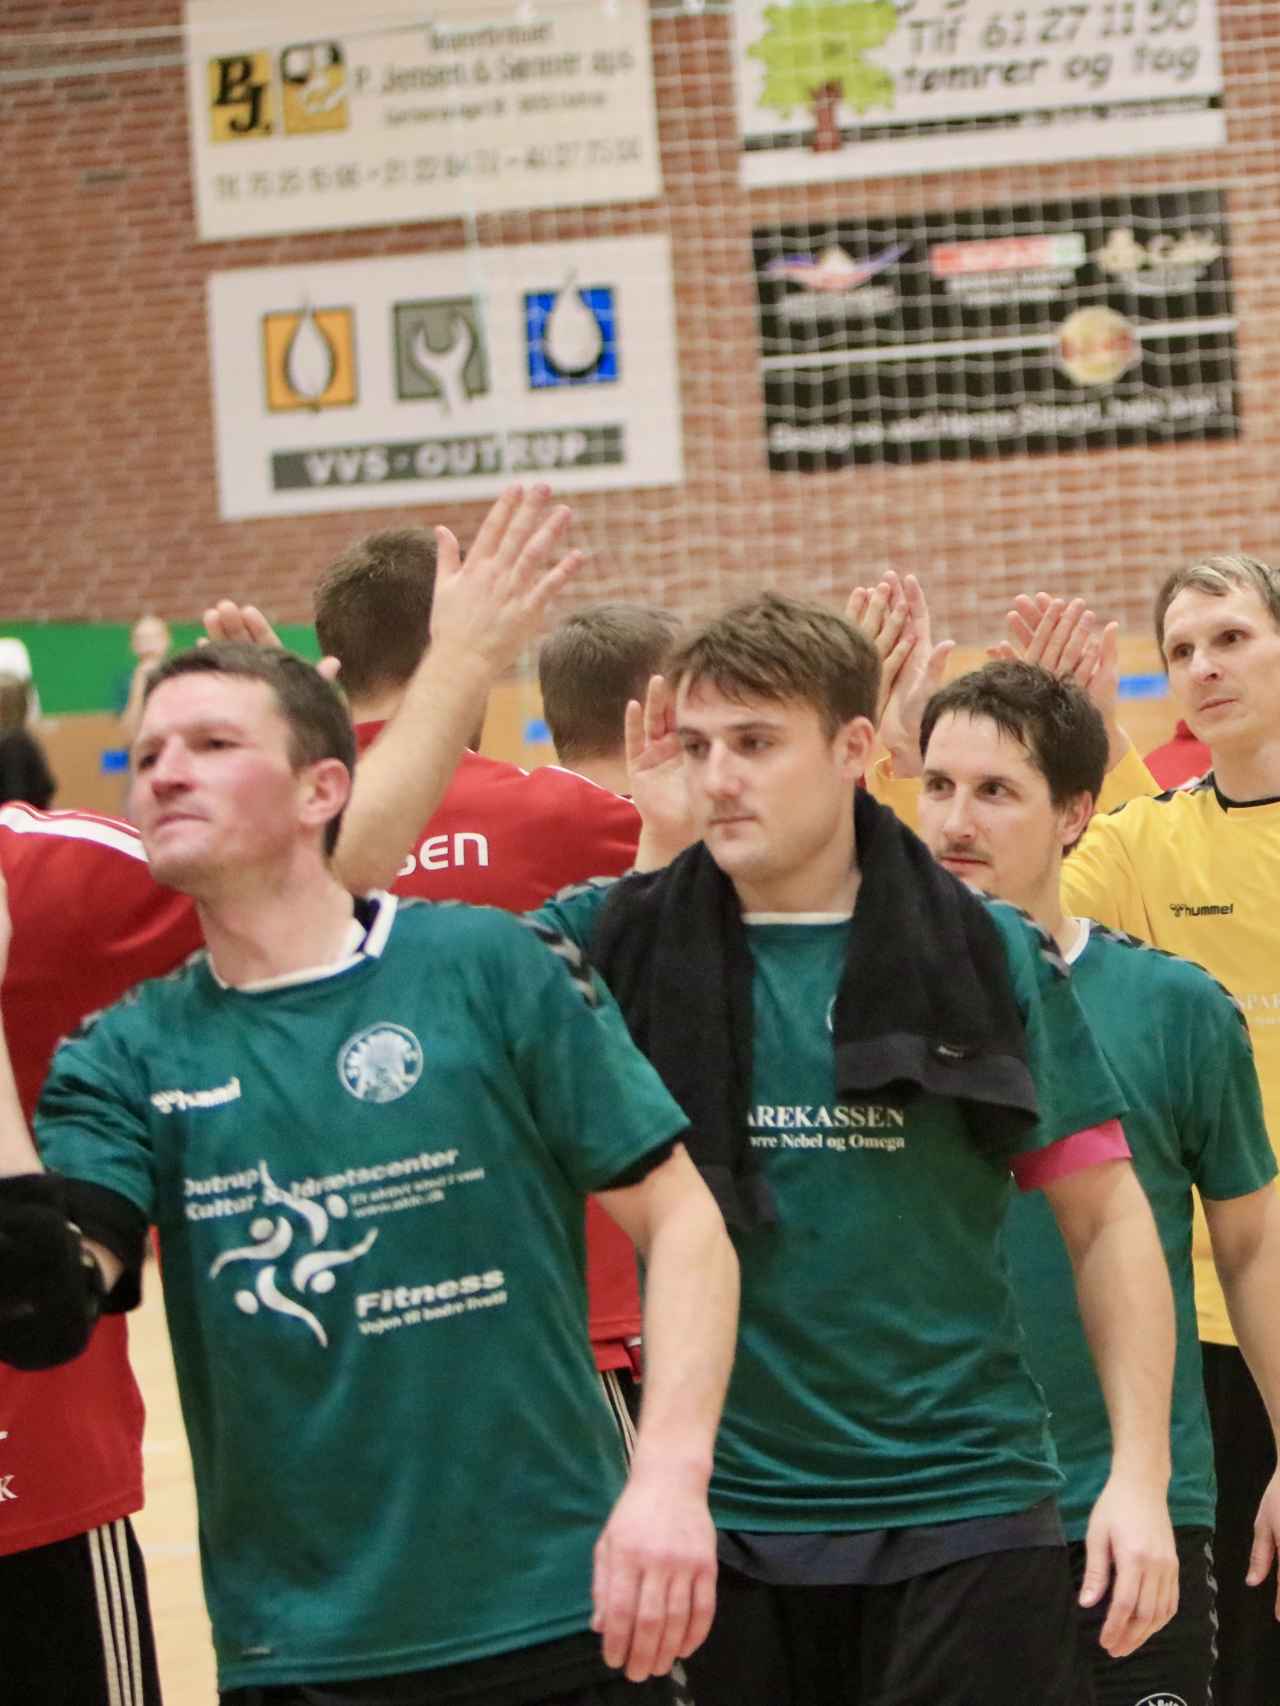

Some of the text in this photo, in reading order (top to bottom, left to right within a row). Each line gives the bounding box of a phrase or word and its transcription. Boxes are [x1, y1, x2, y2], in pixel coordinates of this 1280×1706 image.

[1038, 3, 1088, 43] 27
[305, 431, 588, 484] VVS OUTRUP
[1185, 903, 1234, 917] hummel
[781, 1133, 823, 1149] Nebel
[826, 1136, 846, 1151] og
[355, 1270, 505, 1318] Fitness
